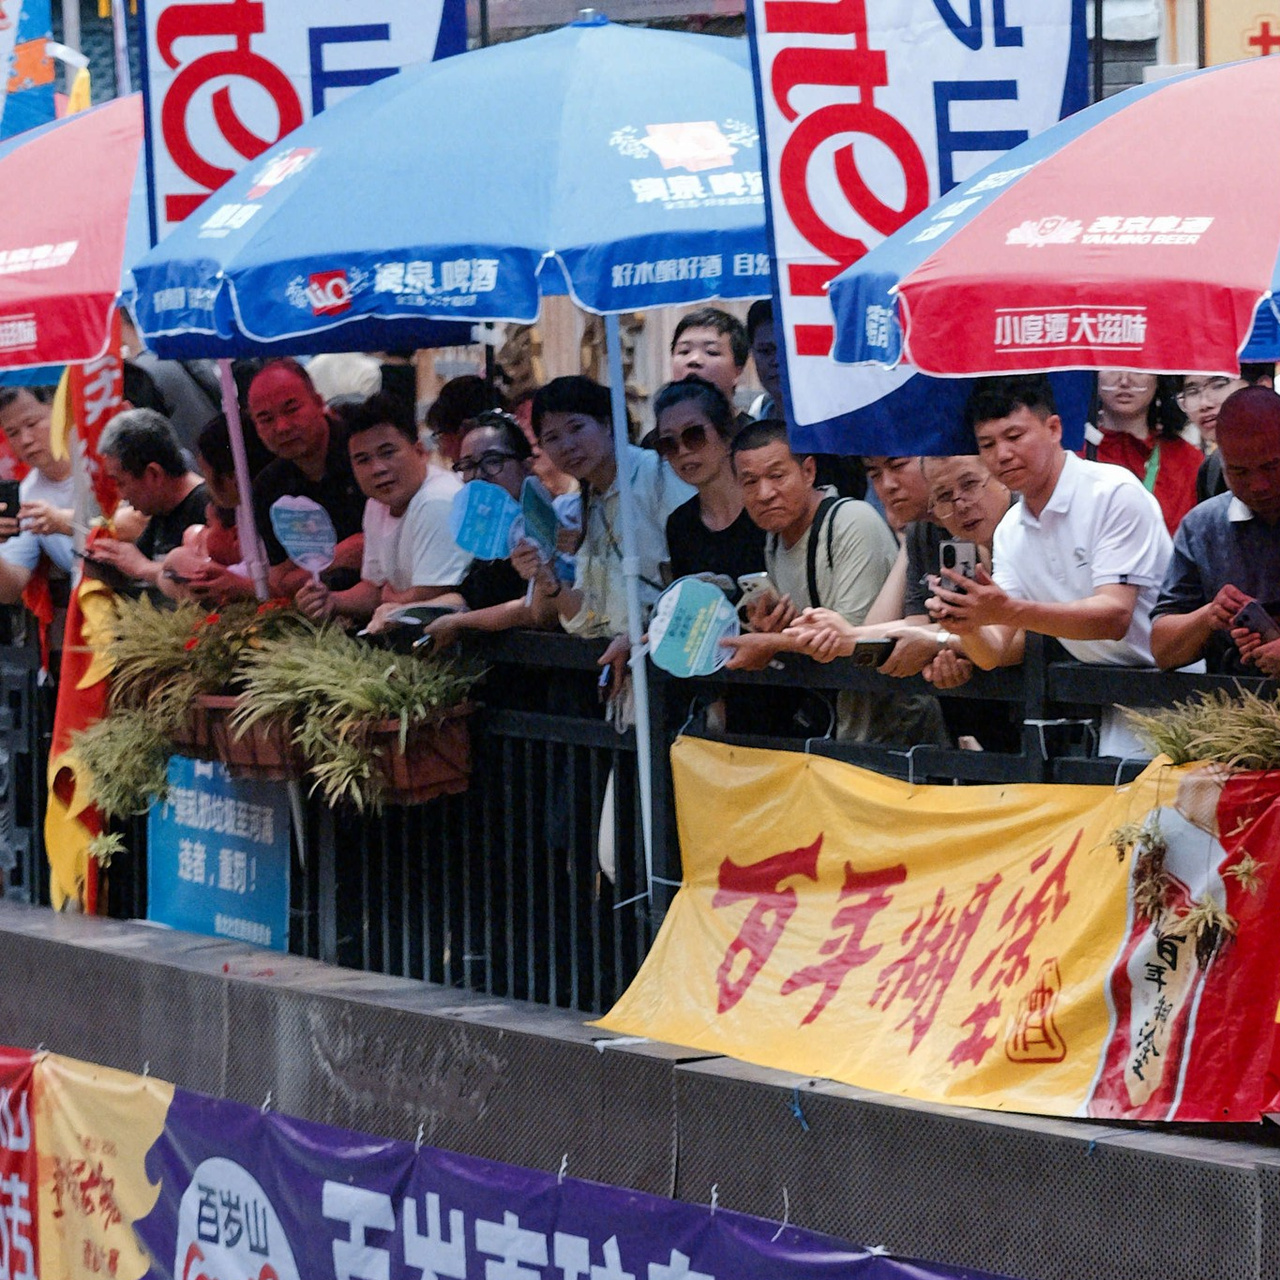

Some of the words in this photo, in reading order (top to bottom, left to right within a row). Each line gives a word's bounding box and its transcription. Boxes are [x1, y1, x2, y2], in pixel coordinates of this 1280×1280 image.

[1150, 234, 1200, 245] BEER
[196, 1183, 270, 1257] 百岁山
